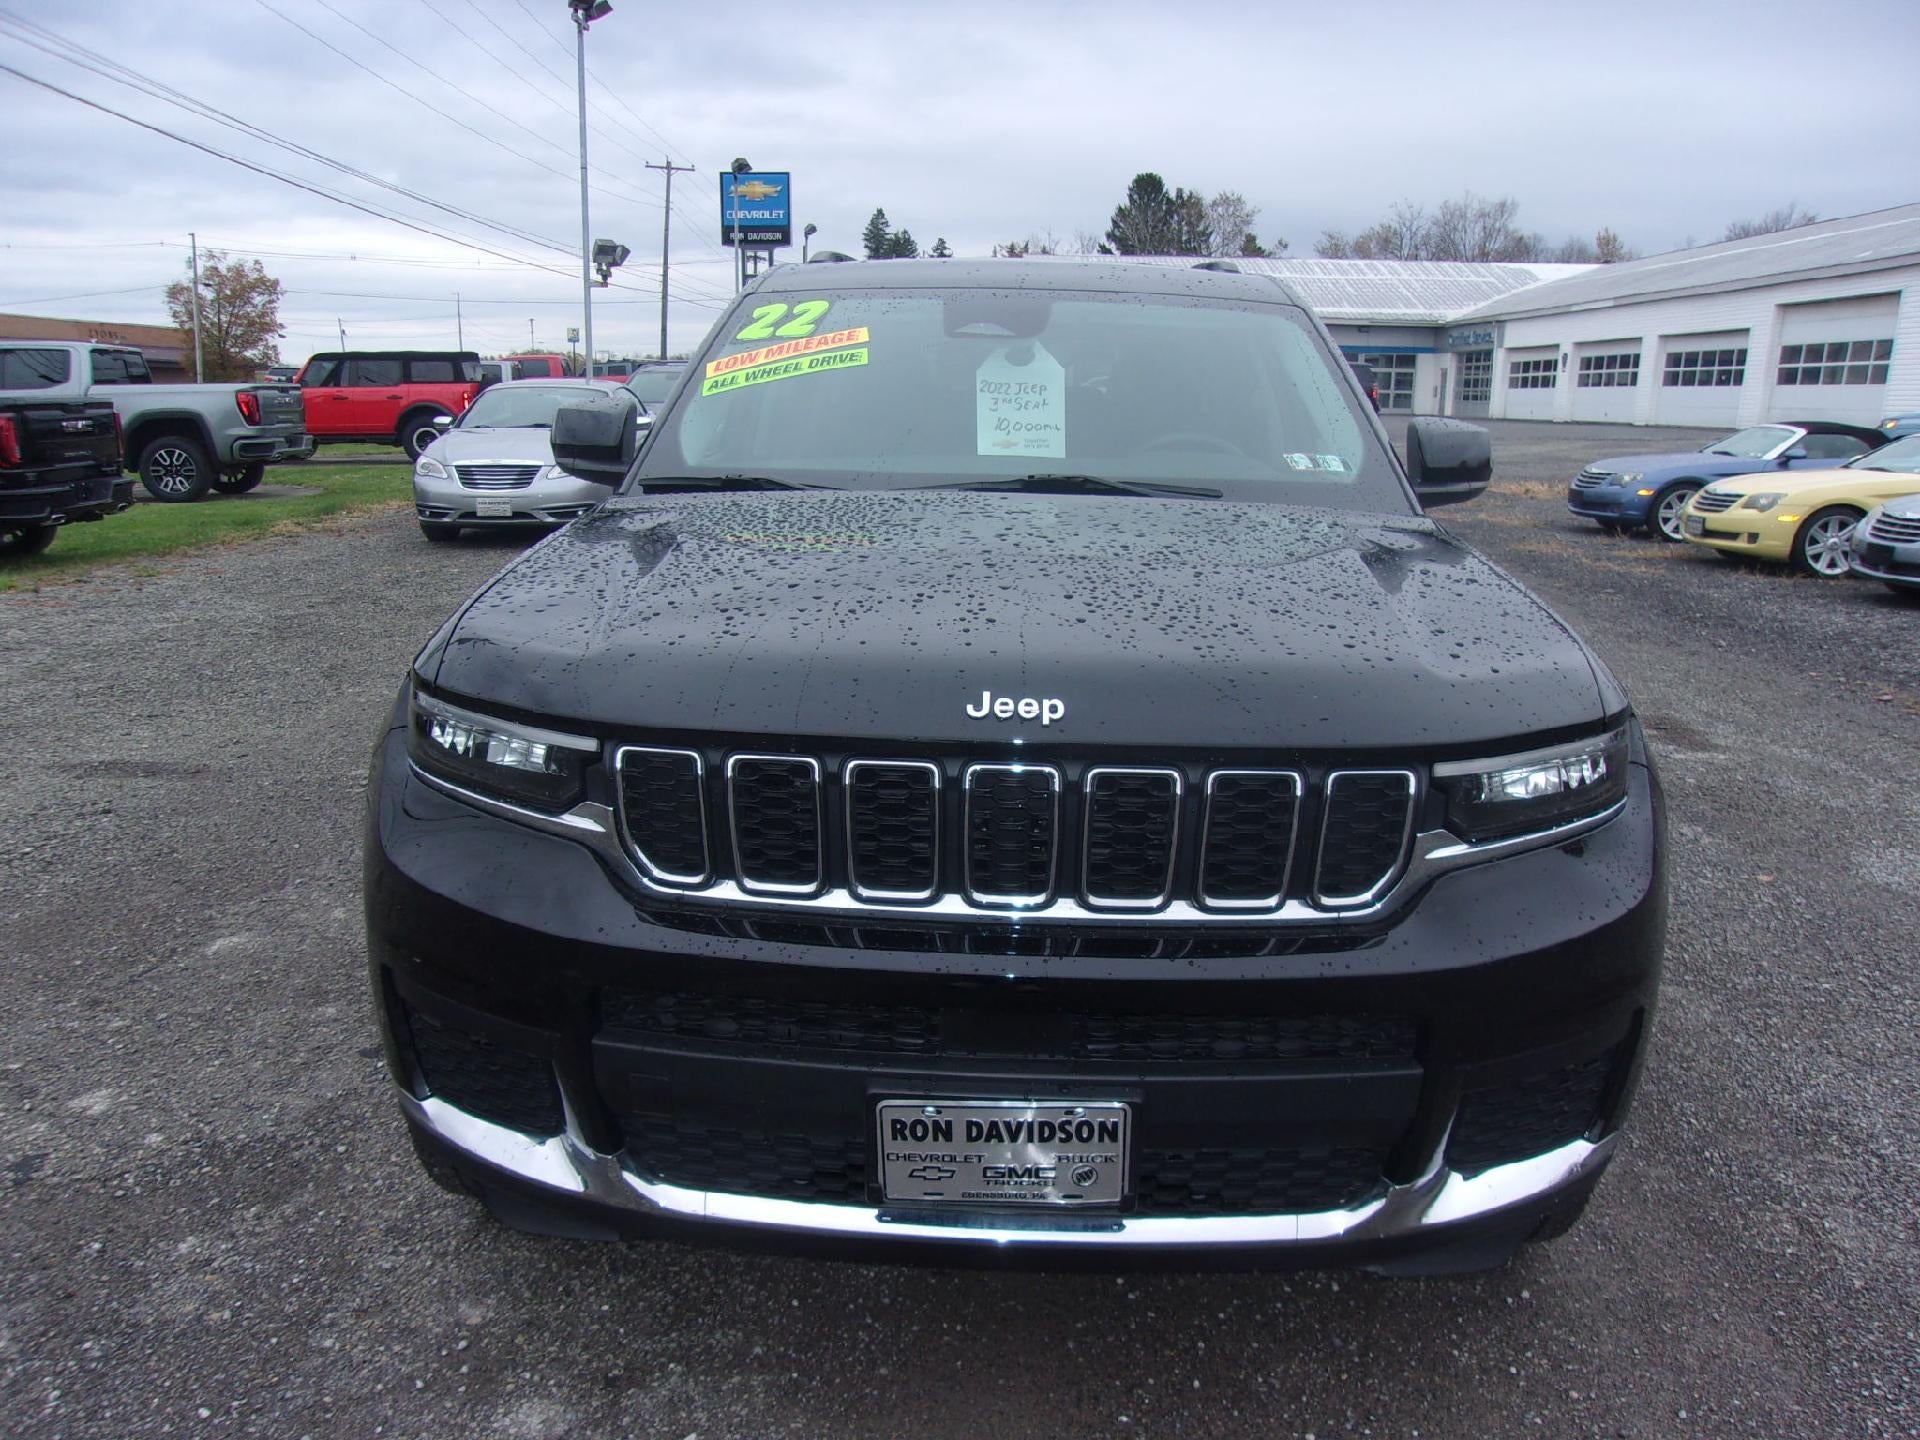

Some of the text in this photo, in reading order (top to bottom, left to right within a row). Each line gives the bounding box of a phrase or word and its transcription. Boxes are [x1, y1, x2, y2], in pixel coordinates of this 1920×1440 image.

[726, 210, 785, 219] CHEVROLET
[747, 232, 783, 241] DAVIDSON
[736, 299, 831, 342] 22
[713, 330, 861, 374] LOW MILEAGE
[707, 351, 865, 392] ALL WHEEL DRIVE
[978, 379, 1012, 395] 2022
[966, 690, 1065, 726] Jeep
[890, 1118, 1120, 1144] RON DAVIDSON
[886, 1152, 985, 1164] CHEVROLET
[1055, 1153, 1119, 1164] BUICK
[982, 1165, 1057, 1179] GMC
[984, 1179, 1056, 1187] TRUCKS
